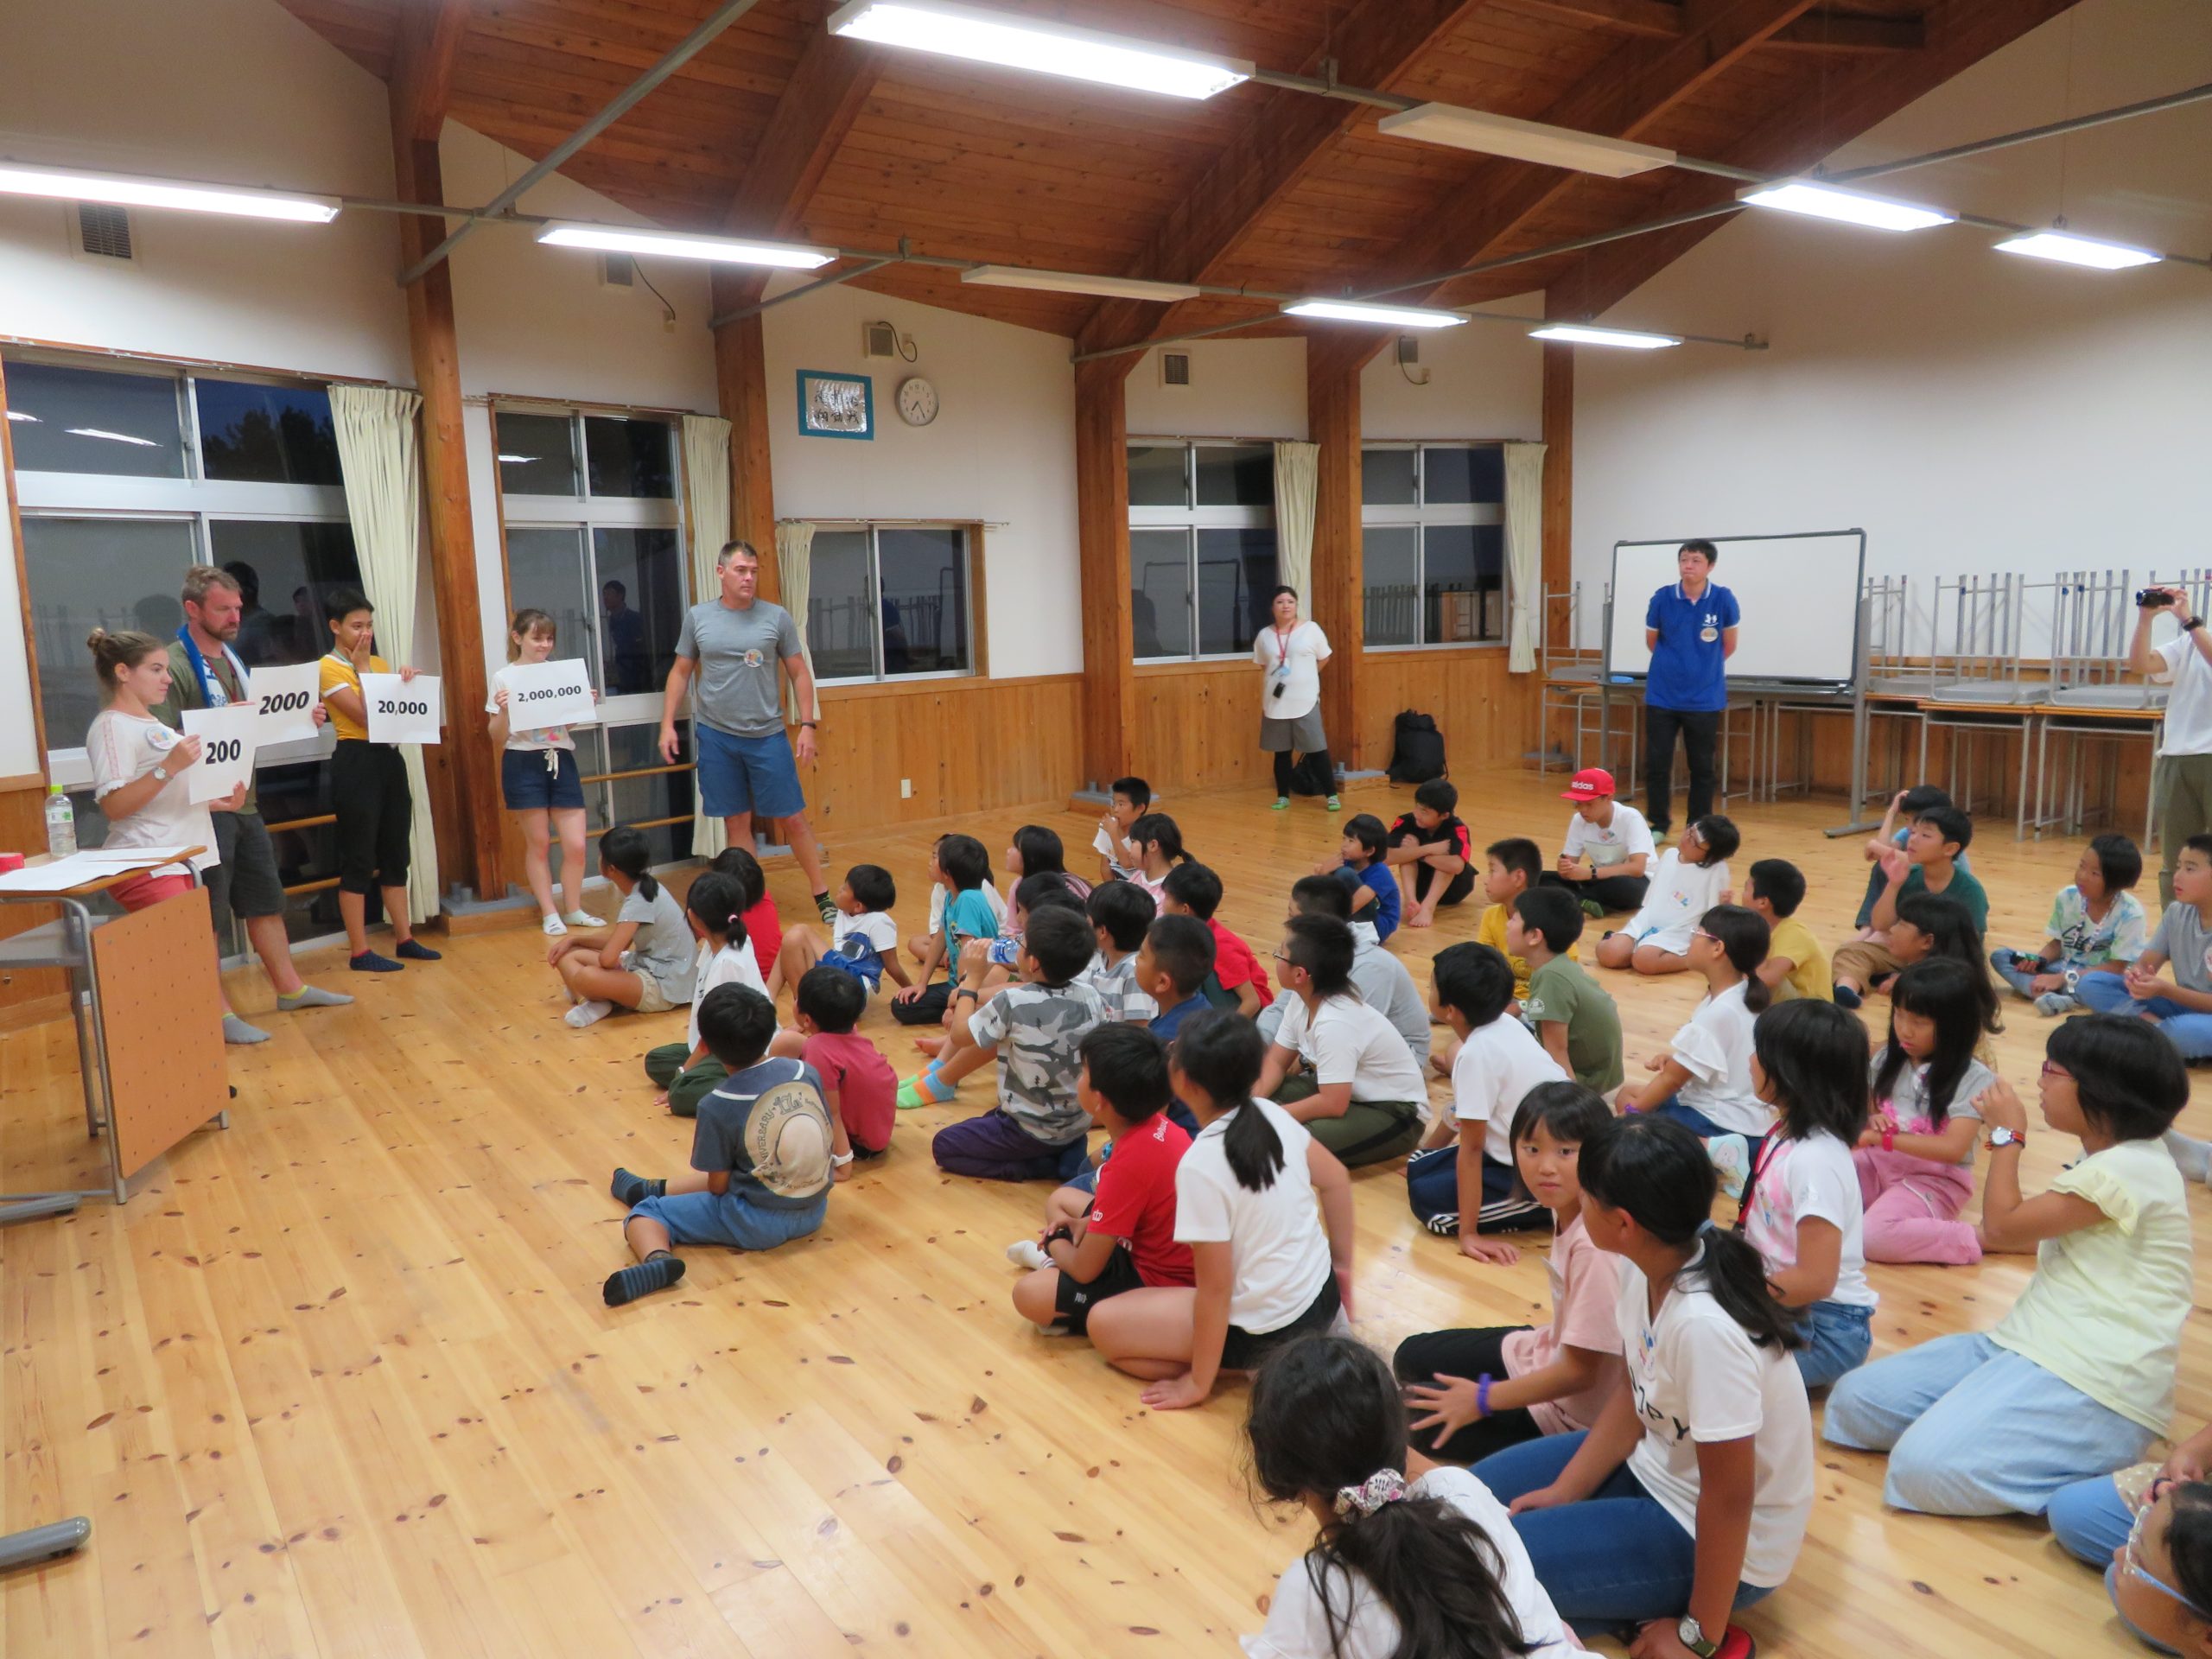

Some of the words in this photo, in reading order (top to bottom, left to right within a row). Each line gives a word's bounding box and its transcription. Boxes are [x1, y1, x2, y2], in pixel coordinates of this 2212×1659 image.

[259, 691, 309, 715] 2000
[518, 685, 582, 702] 2,000,000
[378, 700, 428, 715] 20,000
[206, 739, 241, 765] 200
